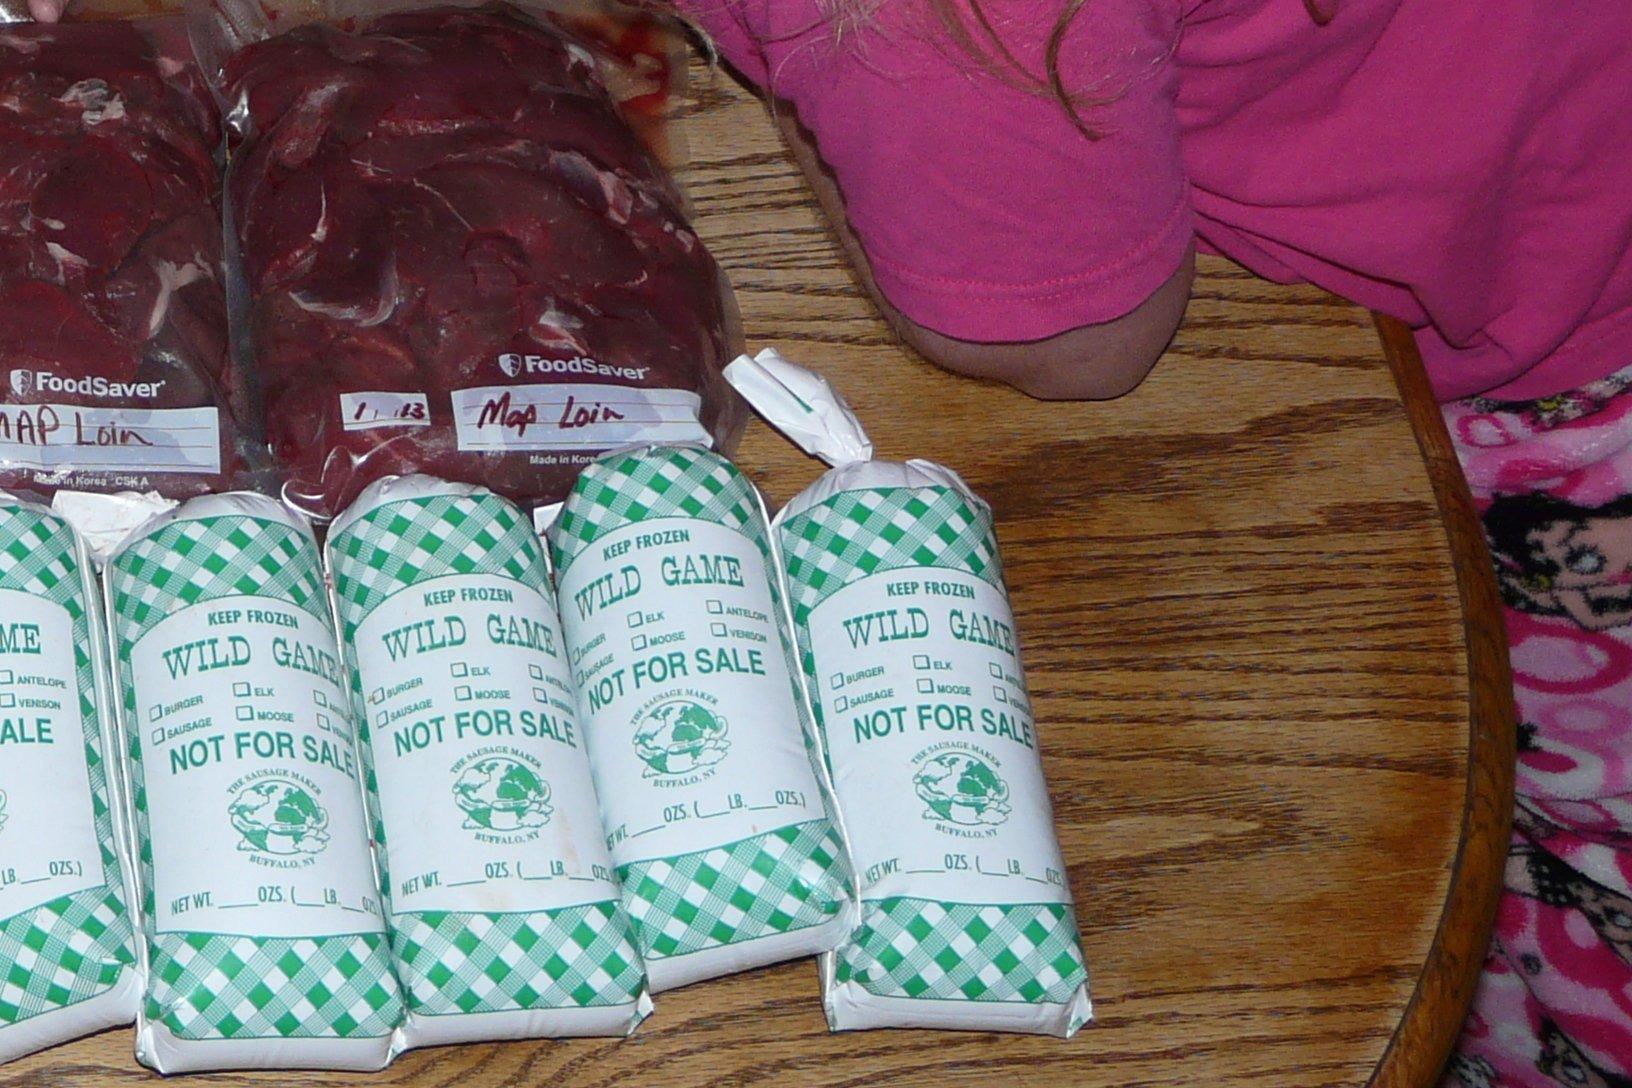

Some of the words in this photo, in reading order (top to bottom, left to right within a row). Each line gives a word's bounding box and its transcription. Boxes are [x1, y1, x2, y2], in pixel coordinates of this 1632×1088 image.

[526, 356, 646, 380] FoodSaver
[36, 372, 161, 397] FoodSaver
[478, 392, 537, 437] Map
[559, 397, 625, 429] Loin
[76, 412, 154, 447] Loin
[529, 455, 557, 465] Made
[559, 455, 570, 465] in
[571, 455, 601, 465] Kore
[603, 540, 631, 561] KEEP
[637, 529, 690, 549] FROZEN
[424, 590, 456, 606] KEEP
[461, 588, 513, 603] FROZEN
[575, 565, 641, 622] WILD
[662, 554, 744, 587] GAME
[887, 582, 919, 596] KEEP
[925, 582, 975, 599] FROZEN
[209, 611, 242, 626] KEEP
[247, 610, 298, 629] FROZEN
[843, 608, 929, 649] WILD
[949, 609, 1015, 656] GAME
[382, 616, 466, 661] WILD
[487, 614, 557, 658] GAME
[162, 636, 251, 680] WILD
[273, 637, 339, 687] GAME
[17, 676, 67, 689] ANTELOPE
[589, 670, 625, 712] NOT
[633, 656, 688, 689] FOR
[697, 648, 765, 675] SALE
[19, 698, 61, 710] VENISON
[164, 696, 204, 715] BURGER
[254, 688, 275, 697] ELK
[391, 699, 433, 722] SAUSAGE
[475, 690, 511, 700] MOOSE
[850, 689, 894, 707] SAUSAGE
[937, 685, 971, 696] MOOSE
[167, 718, 212, 739] SAUSAGE
[257, 711, 294, 722] MOOSE
[394, 716, 446, 757] NOT
[455, 710, 514, 739] FOR
[520, 710, 577, 748] SALE
[854, 707, 907, 744] NOT
[918, 704, 974, 731] FOR
[982, 708, 1034, 750] SALE
[170, 736, 224, 775] NOT
[235, 731, 295, 759] FOR
[303, 736, 355, 779] SALE
[468, 746, 508, 759] SAUSAGE
[511, 747, 542, 769] MAKER
[928, 742, 969, 755] SAUSAGE
[245, 769, 289, 781] SAUSAGE
[291, 771, 322, 794] MAKER
[402, 877, 419, 896] NET
[422, 872, 442, 888] WT.
[485, 862, 513, 877] OZS.
[866, 865, 881, 885] NET
[882, 858, 901, 874] WT.
[945, 854, 972, 870] OZS.
[172, 896, 190, 915] NET
[193, 892, 214, 908] WT.
[259, 886, 286, 902] OZS.
